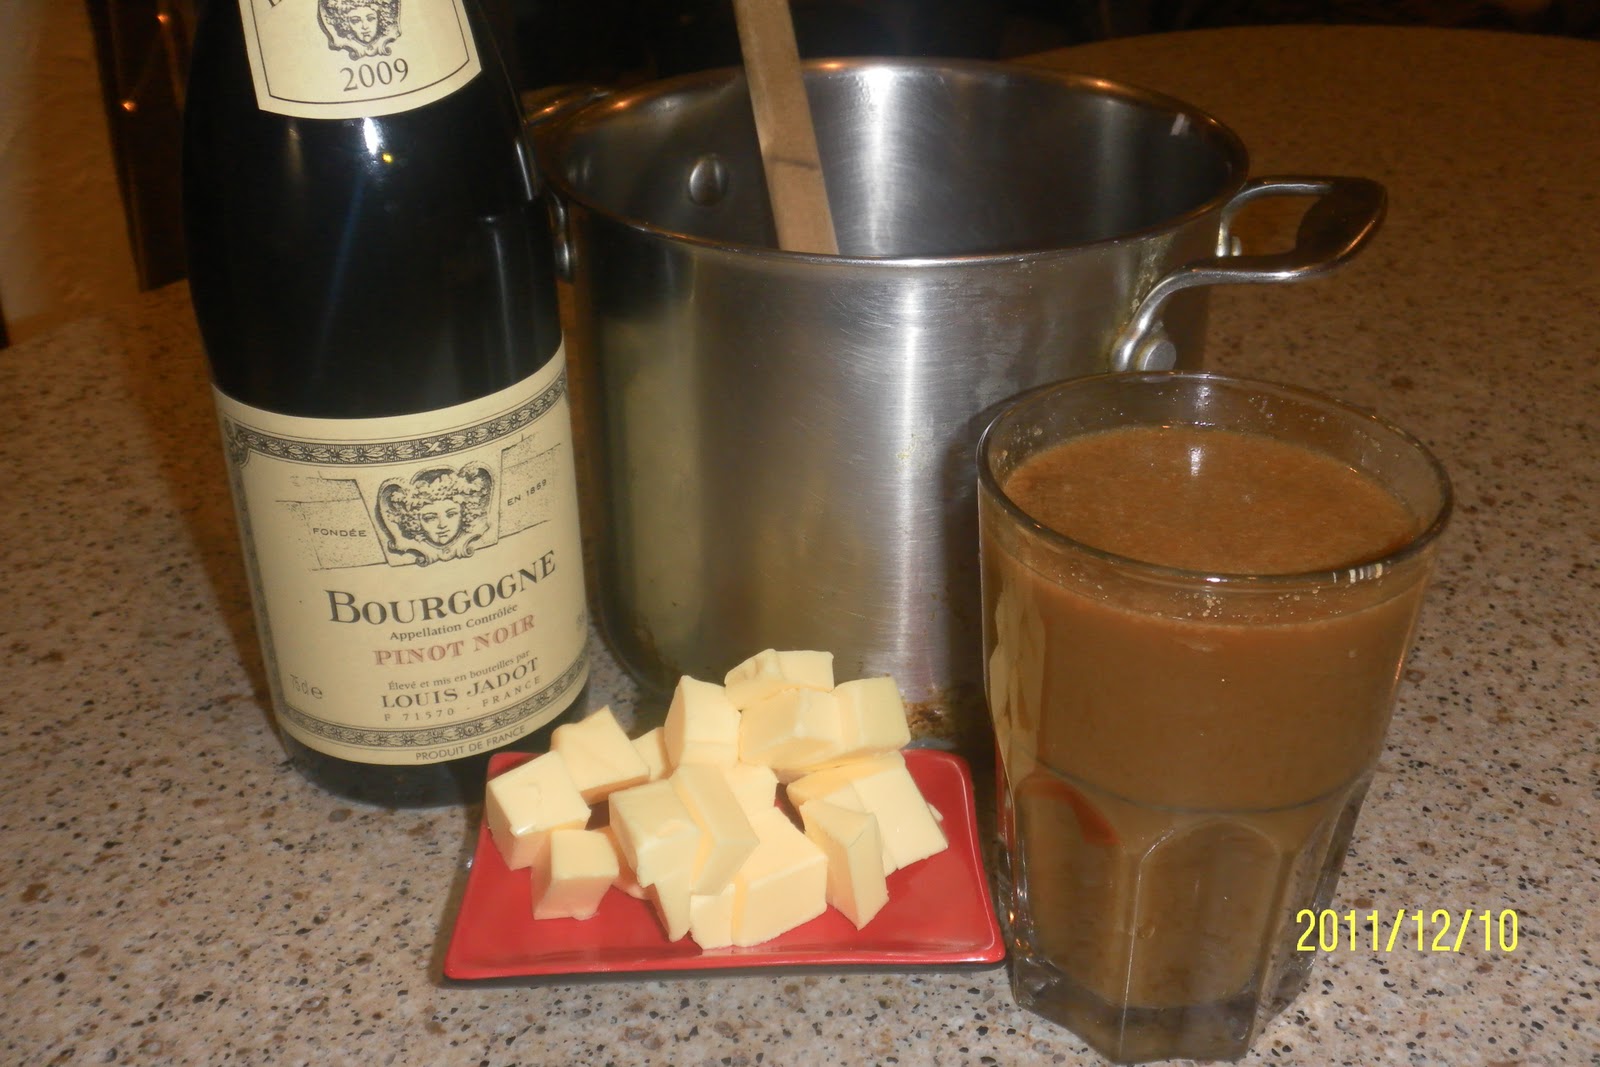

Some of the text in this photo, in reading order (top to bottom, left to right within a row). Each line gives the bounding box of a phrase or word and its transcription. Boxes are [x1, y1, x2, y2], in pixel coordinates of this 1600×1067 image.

[340, 58, 409, 92] 2009
[507, 494, 521, 506] EN
[312, 528, 367, 538] FONDÉE
[324, 550, 556, 626] BOURGOGNE
[373, 613, 536, 666] PINOT NOIR
[390, 603, 518, 641] Appellation Contrôlée
[381, 657, 539, 709] LOUIS JADOT
[388, 650, 531, 691] Élevé et mis en bouteilles par
[384, 713, 391, 722] F
[402, 707, 455, 722] 71570
[482, 675, 541, 707] FRANCE
[416, 724, 526, 761] PRODUIT DE FRANCE
